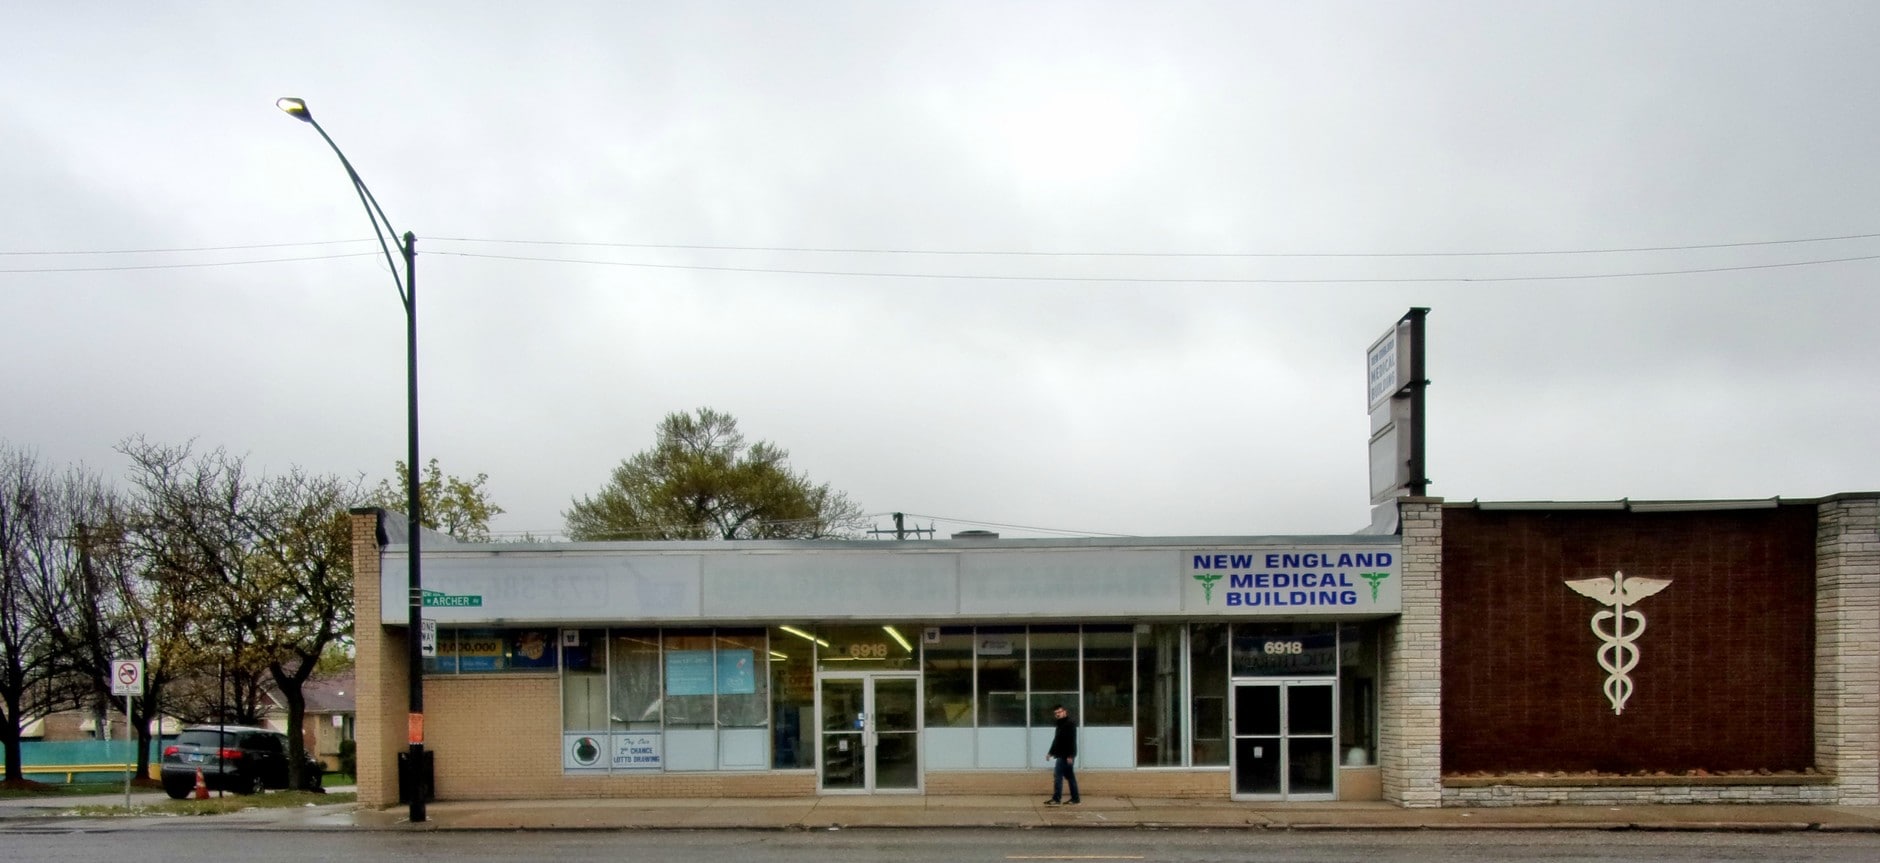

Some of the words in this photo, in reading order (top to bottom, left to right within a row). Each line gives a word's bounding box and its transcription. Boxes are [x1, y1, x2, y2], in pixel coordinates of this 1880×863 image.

[1371, 353, 1395, 384] MEDICAL
[1371, 370, 1395, 401] BUILDING
[1193, 554, 1253, 570] NEW
[1265, 553, 1393, 569] ENGLAND
[1230, 573, 1353, 588] MEDICAL
[432, 596, 470, 606] ARCHER
[1226, 590, 1357, 607] BUILDING
[850, 643, 888, 657] 6918
[1264, 641, 1303, 655] 6918
[613, 756, 632, 764] LOTTO
